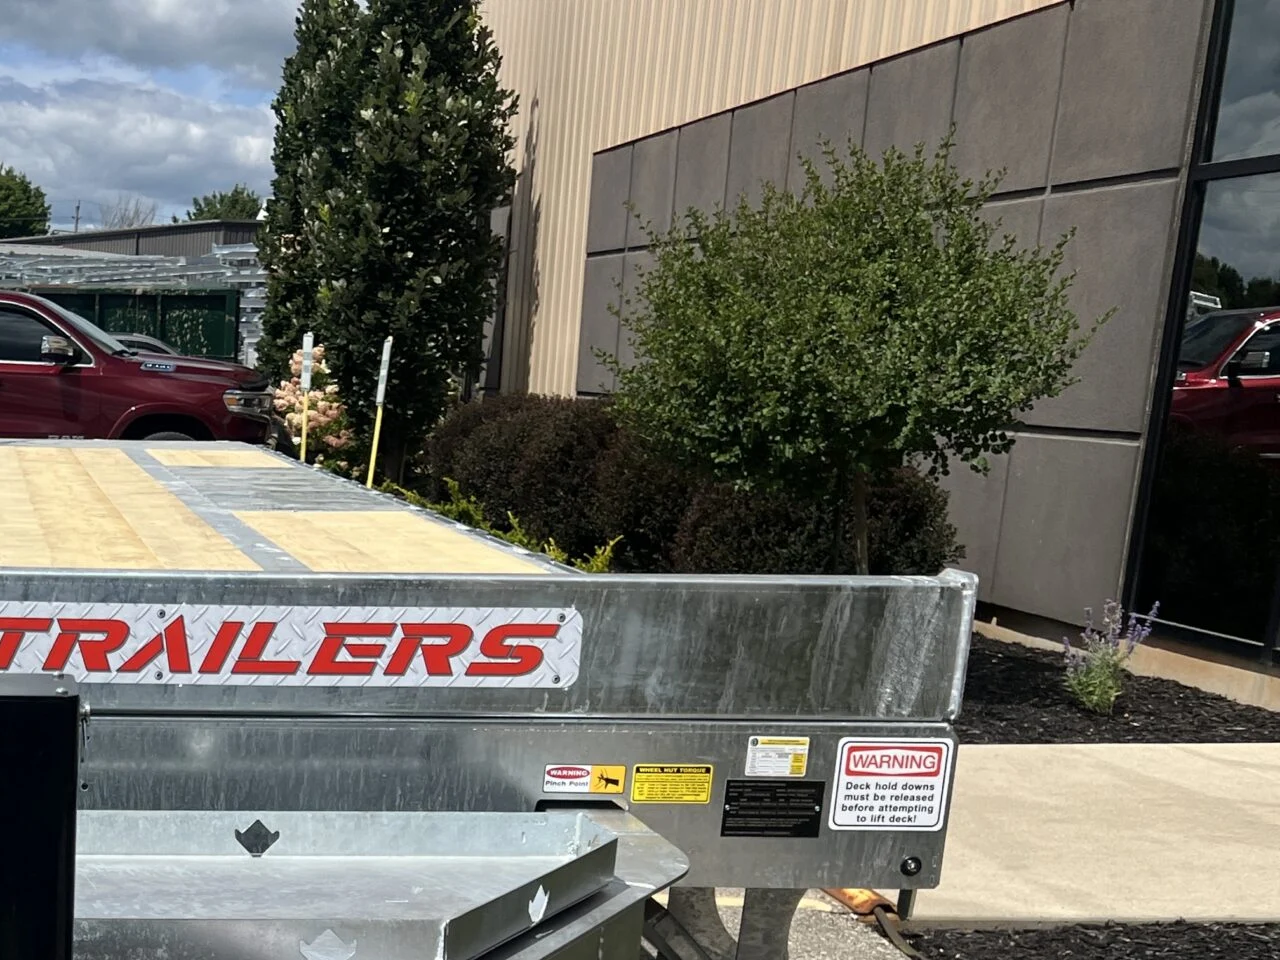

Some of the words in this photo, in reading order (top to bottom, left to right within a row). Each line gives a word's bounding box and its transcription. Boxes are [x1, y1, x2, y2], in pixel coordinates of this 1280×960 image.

[852, 754, 936, 769] WARNING
[550, 768, 587, 776] WARNING
[845, 781, 871, 791] Deck
[875, 782, 897, 791] hold
[901, 782, 935, 791] downs
[844, 793, 870, 801] must
[873, 793, 886, 801] be
[890, 793, 934, 802] released
[841, 803, 875, 812] before
[878, 804, 934, 814] attempting
[856, 815, 867, 823] to
[870, 815, 885, 823] lift
[889, 815, 916, 823] deck!
